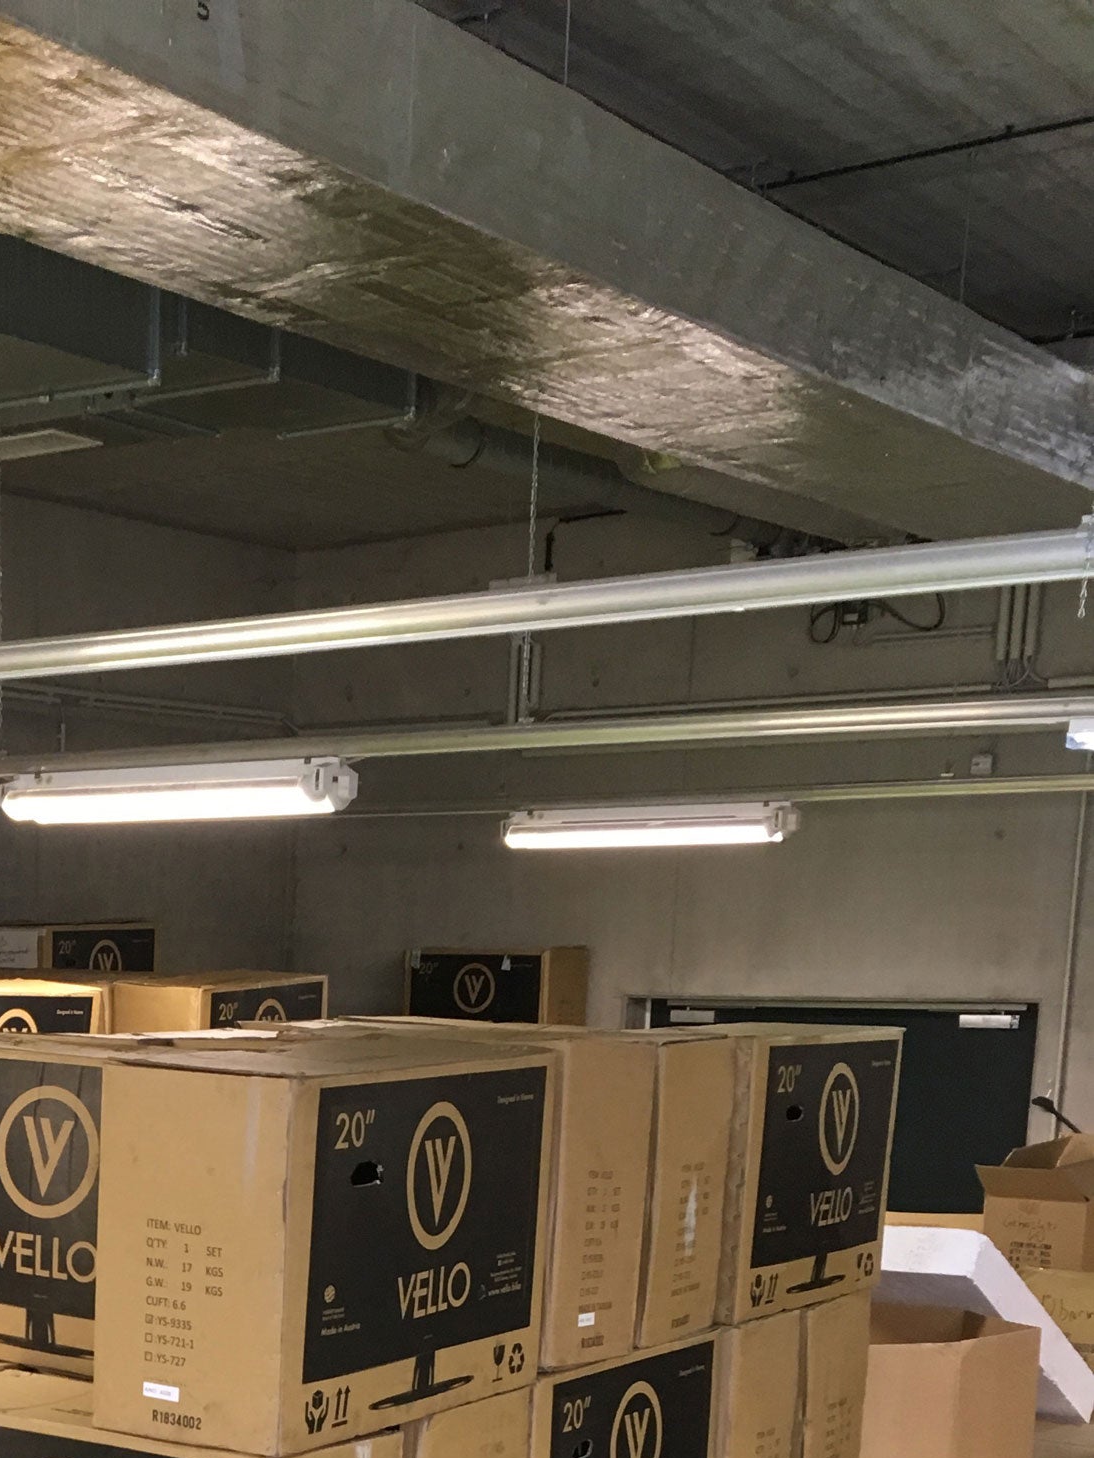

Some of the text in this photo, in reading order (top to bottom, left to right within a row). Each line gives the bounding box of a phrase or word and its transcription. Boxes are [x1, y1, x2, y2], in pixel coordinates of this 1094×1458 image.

[778, 1064, 802, 1094] 20"
[335, 1109, 375, 1150] 20"
[810, 1186, 852, 1227] VELLO
[174, 1223, 202, 1236] VELLO
[184, 1244, 189, 1254] 1
[206, 1246, 222, 1258] SET
[182, 1262, 192, 1273] 17
[206, 1266, 223, 1278] KGS
[181, 1282, 192, 1292] 19
[205, 1286, 223, 1297] KGS
[398, 1262, 471, 1320] VELLO
[172, 1300, 186, 1310] 6.6
[152, 1409, 202, 1430] R1834002
[563, 1396, 591, 1433] 20"
